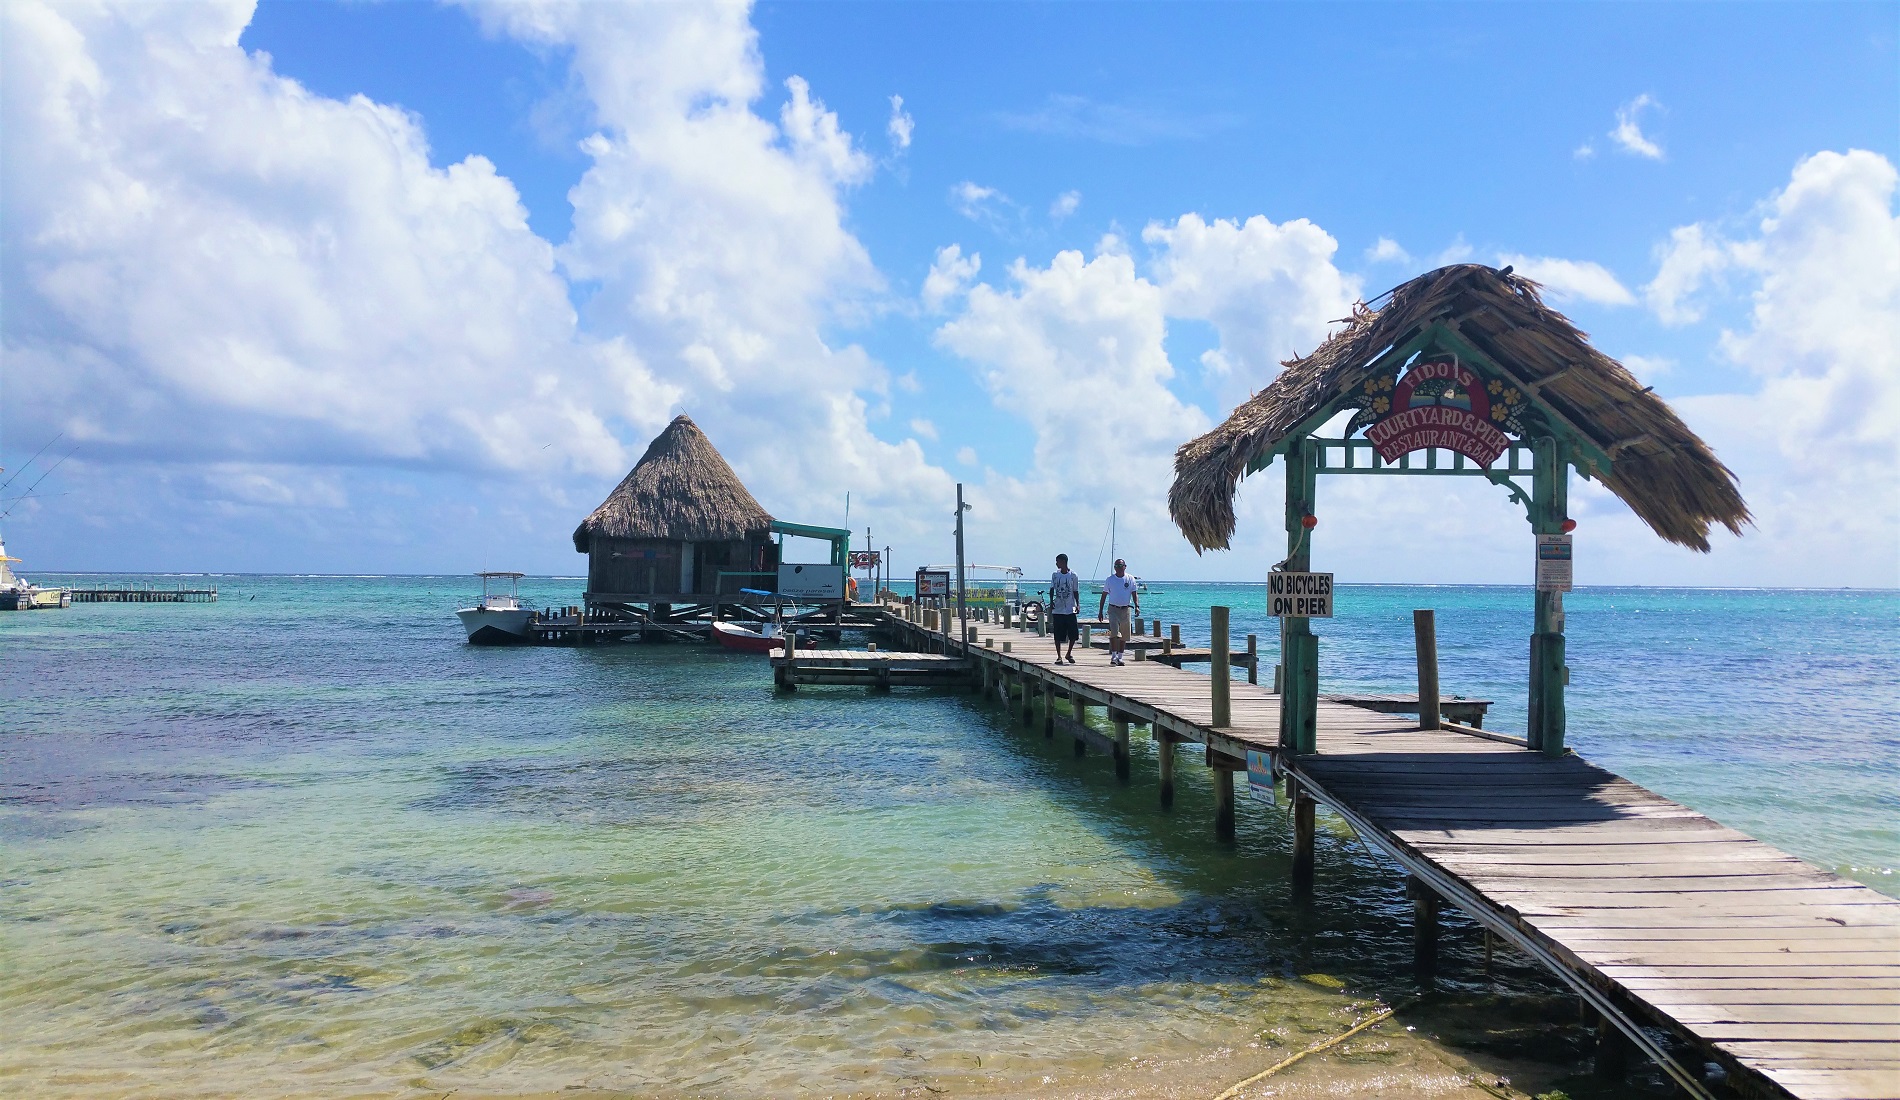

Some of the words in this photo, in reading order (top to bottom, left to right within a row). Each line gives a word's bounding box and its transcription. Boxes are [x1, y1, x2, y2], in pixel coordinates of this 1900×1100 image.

[1270, 575, 1284, 595] NO
[1286, 575, 1330, 595] BICYCLES
[1274, 597, 1293, 615] ON
[1297, 597, 1327, 615] PIER
